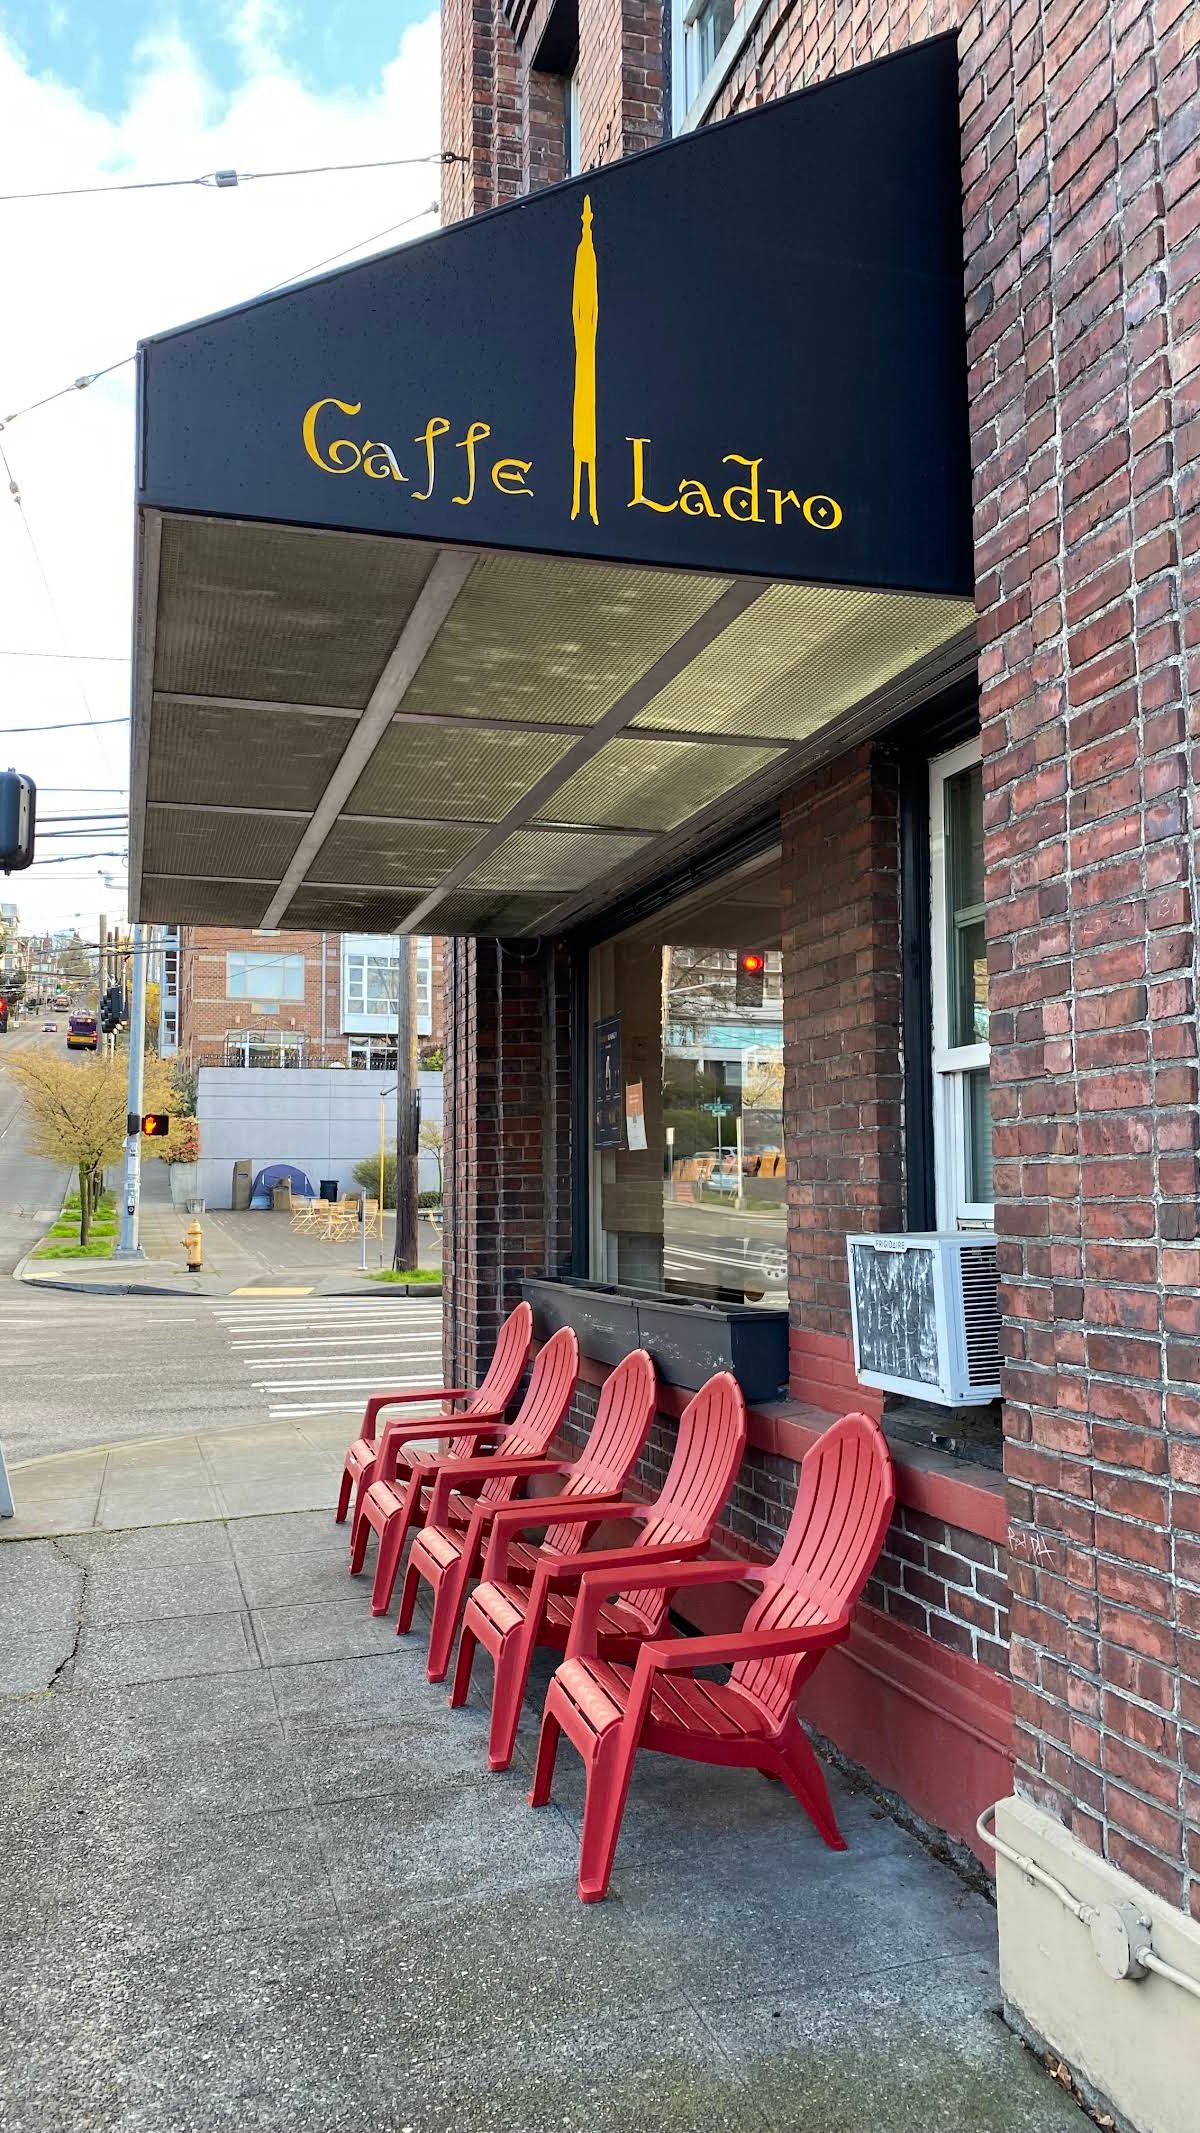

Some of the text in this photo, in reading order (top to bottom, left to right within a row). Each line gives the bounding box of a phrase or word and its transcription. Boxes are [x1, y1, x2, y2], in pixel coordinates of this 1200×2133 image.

[302, 397, 843, 530] Caffe Ladro
[875, 1239, 906, 1250] FRIGIDAIRE
